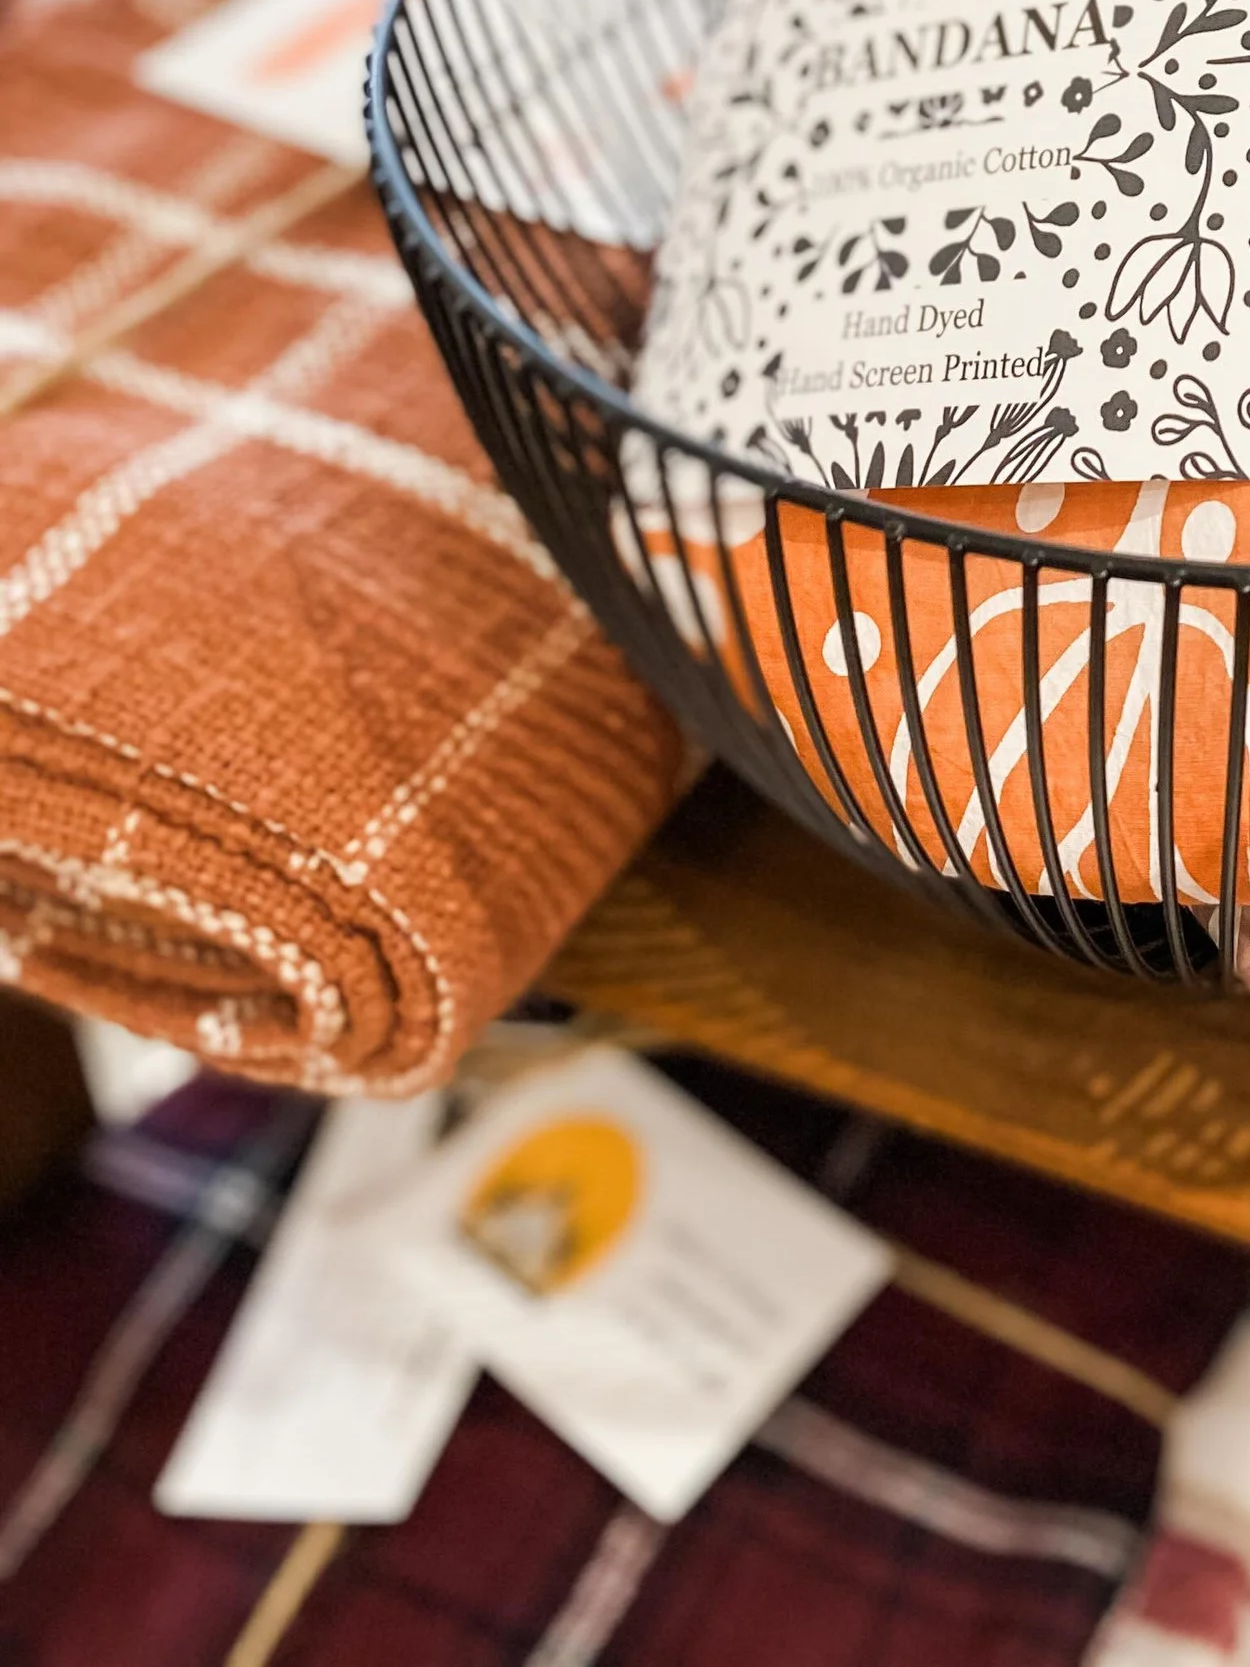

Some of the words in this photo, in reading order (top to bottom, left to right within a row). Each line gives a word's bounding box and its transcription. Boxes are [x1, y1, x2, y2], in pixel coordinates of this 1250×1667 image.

[878, 150, 977, 192] Organic
[983, 139, 1072, 176] Cotton
[842, 301, 910, 339] Hand
[917, 298, 985, 338] Dyed
[848, 359, 933, 389] Screen
[942, 346, 1044, 383] Printed
